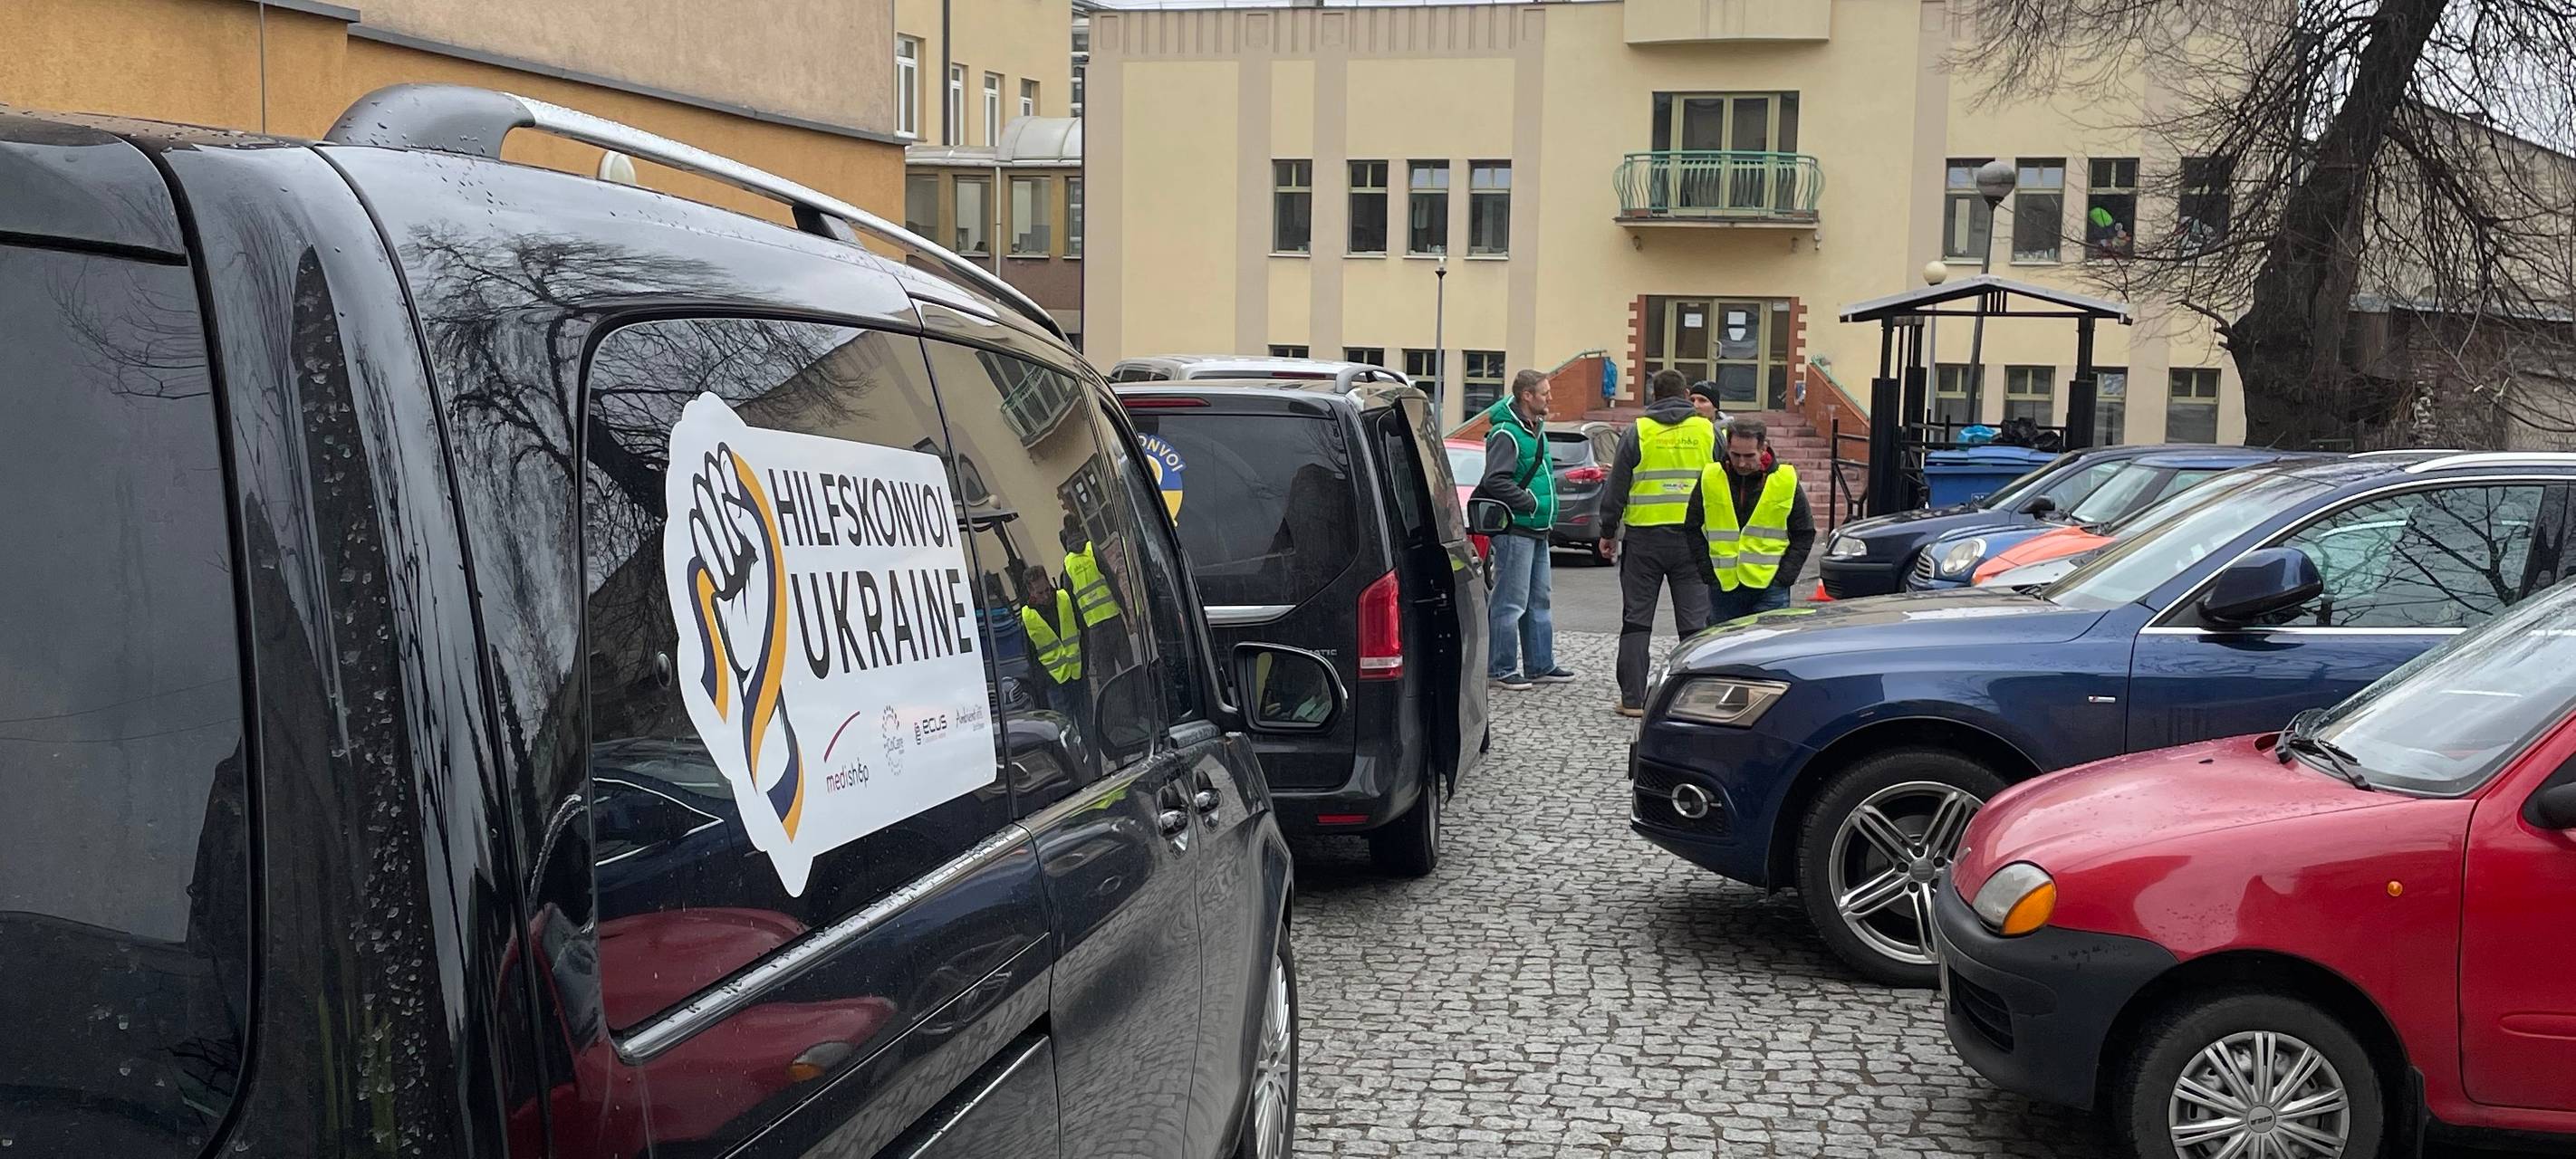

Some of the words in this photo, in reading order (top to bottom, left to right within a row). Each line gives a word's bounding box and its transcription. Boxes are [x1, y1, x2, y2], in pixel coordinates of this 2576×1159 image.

[1138, 435, 1185, 473] ONVOI
[768, 468, 953, 547] HILFSKONVOI
[791, 568, 973, 680] UKRAINE
[922, 714, 948, 735] ecus
[826, 761, 870, 793] medishop
